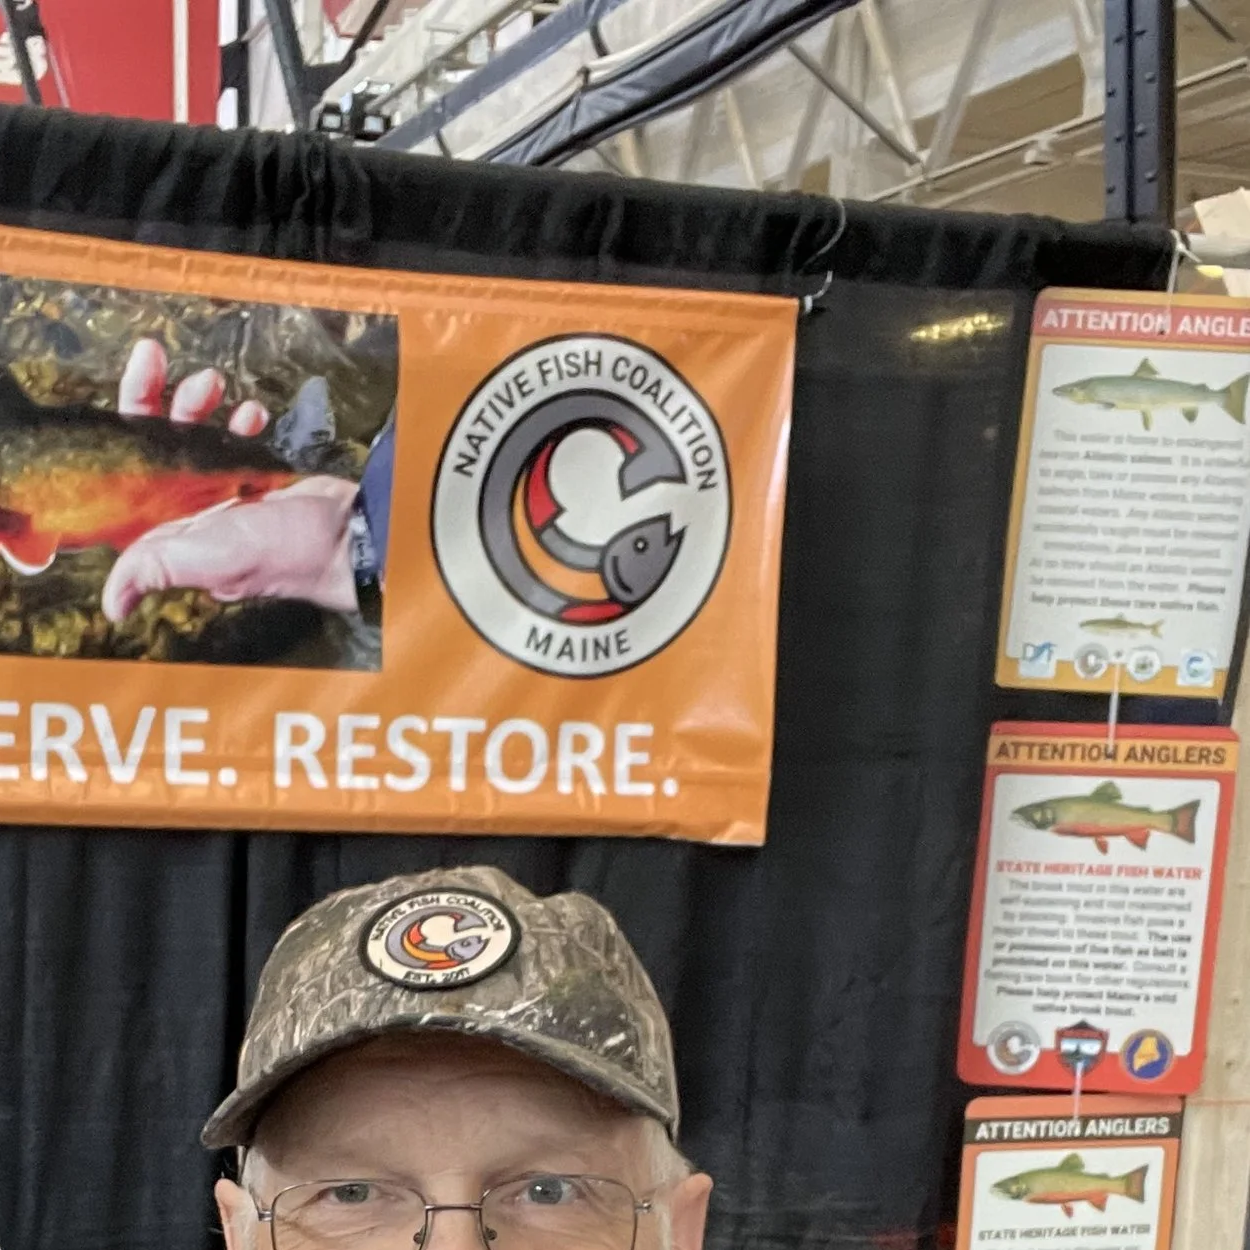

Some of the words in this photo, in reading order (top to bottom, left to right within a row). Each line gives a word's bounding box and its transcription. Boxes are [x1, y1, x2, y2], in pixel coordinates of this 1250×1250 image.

[1042, 308, 1171, 334] ATTENTION
[453, 370, 534, 478] NATIVE
[537, 350, 602, 386] FISH
[611, 356, 718, 492] COALITION
[525, 626, 631, 663] MAINE
[273, 712, 679, 798] RESTORE.
[995, 742, 1120, 760] ATTENTION
[1124, 745, 1226, 765] ANGLERS
[407, 896, 440, 909] FISH
[975, 1119, 1081, 1140] ATTENTION
[1085, 1116, 1170, 1137] ANGLERS
